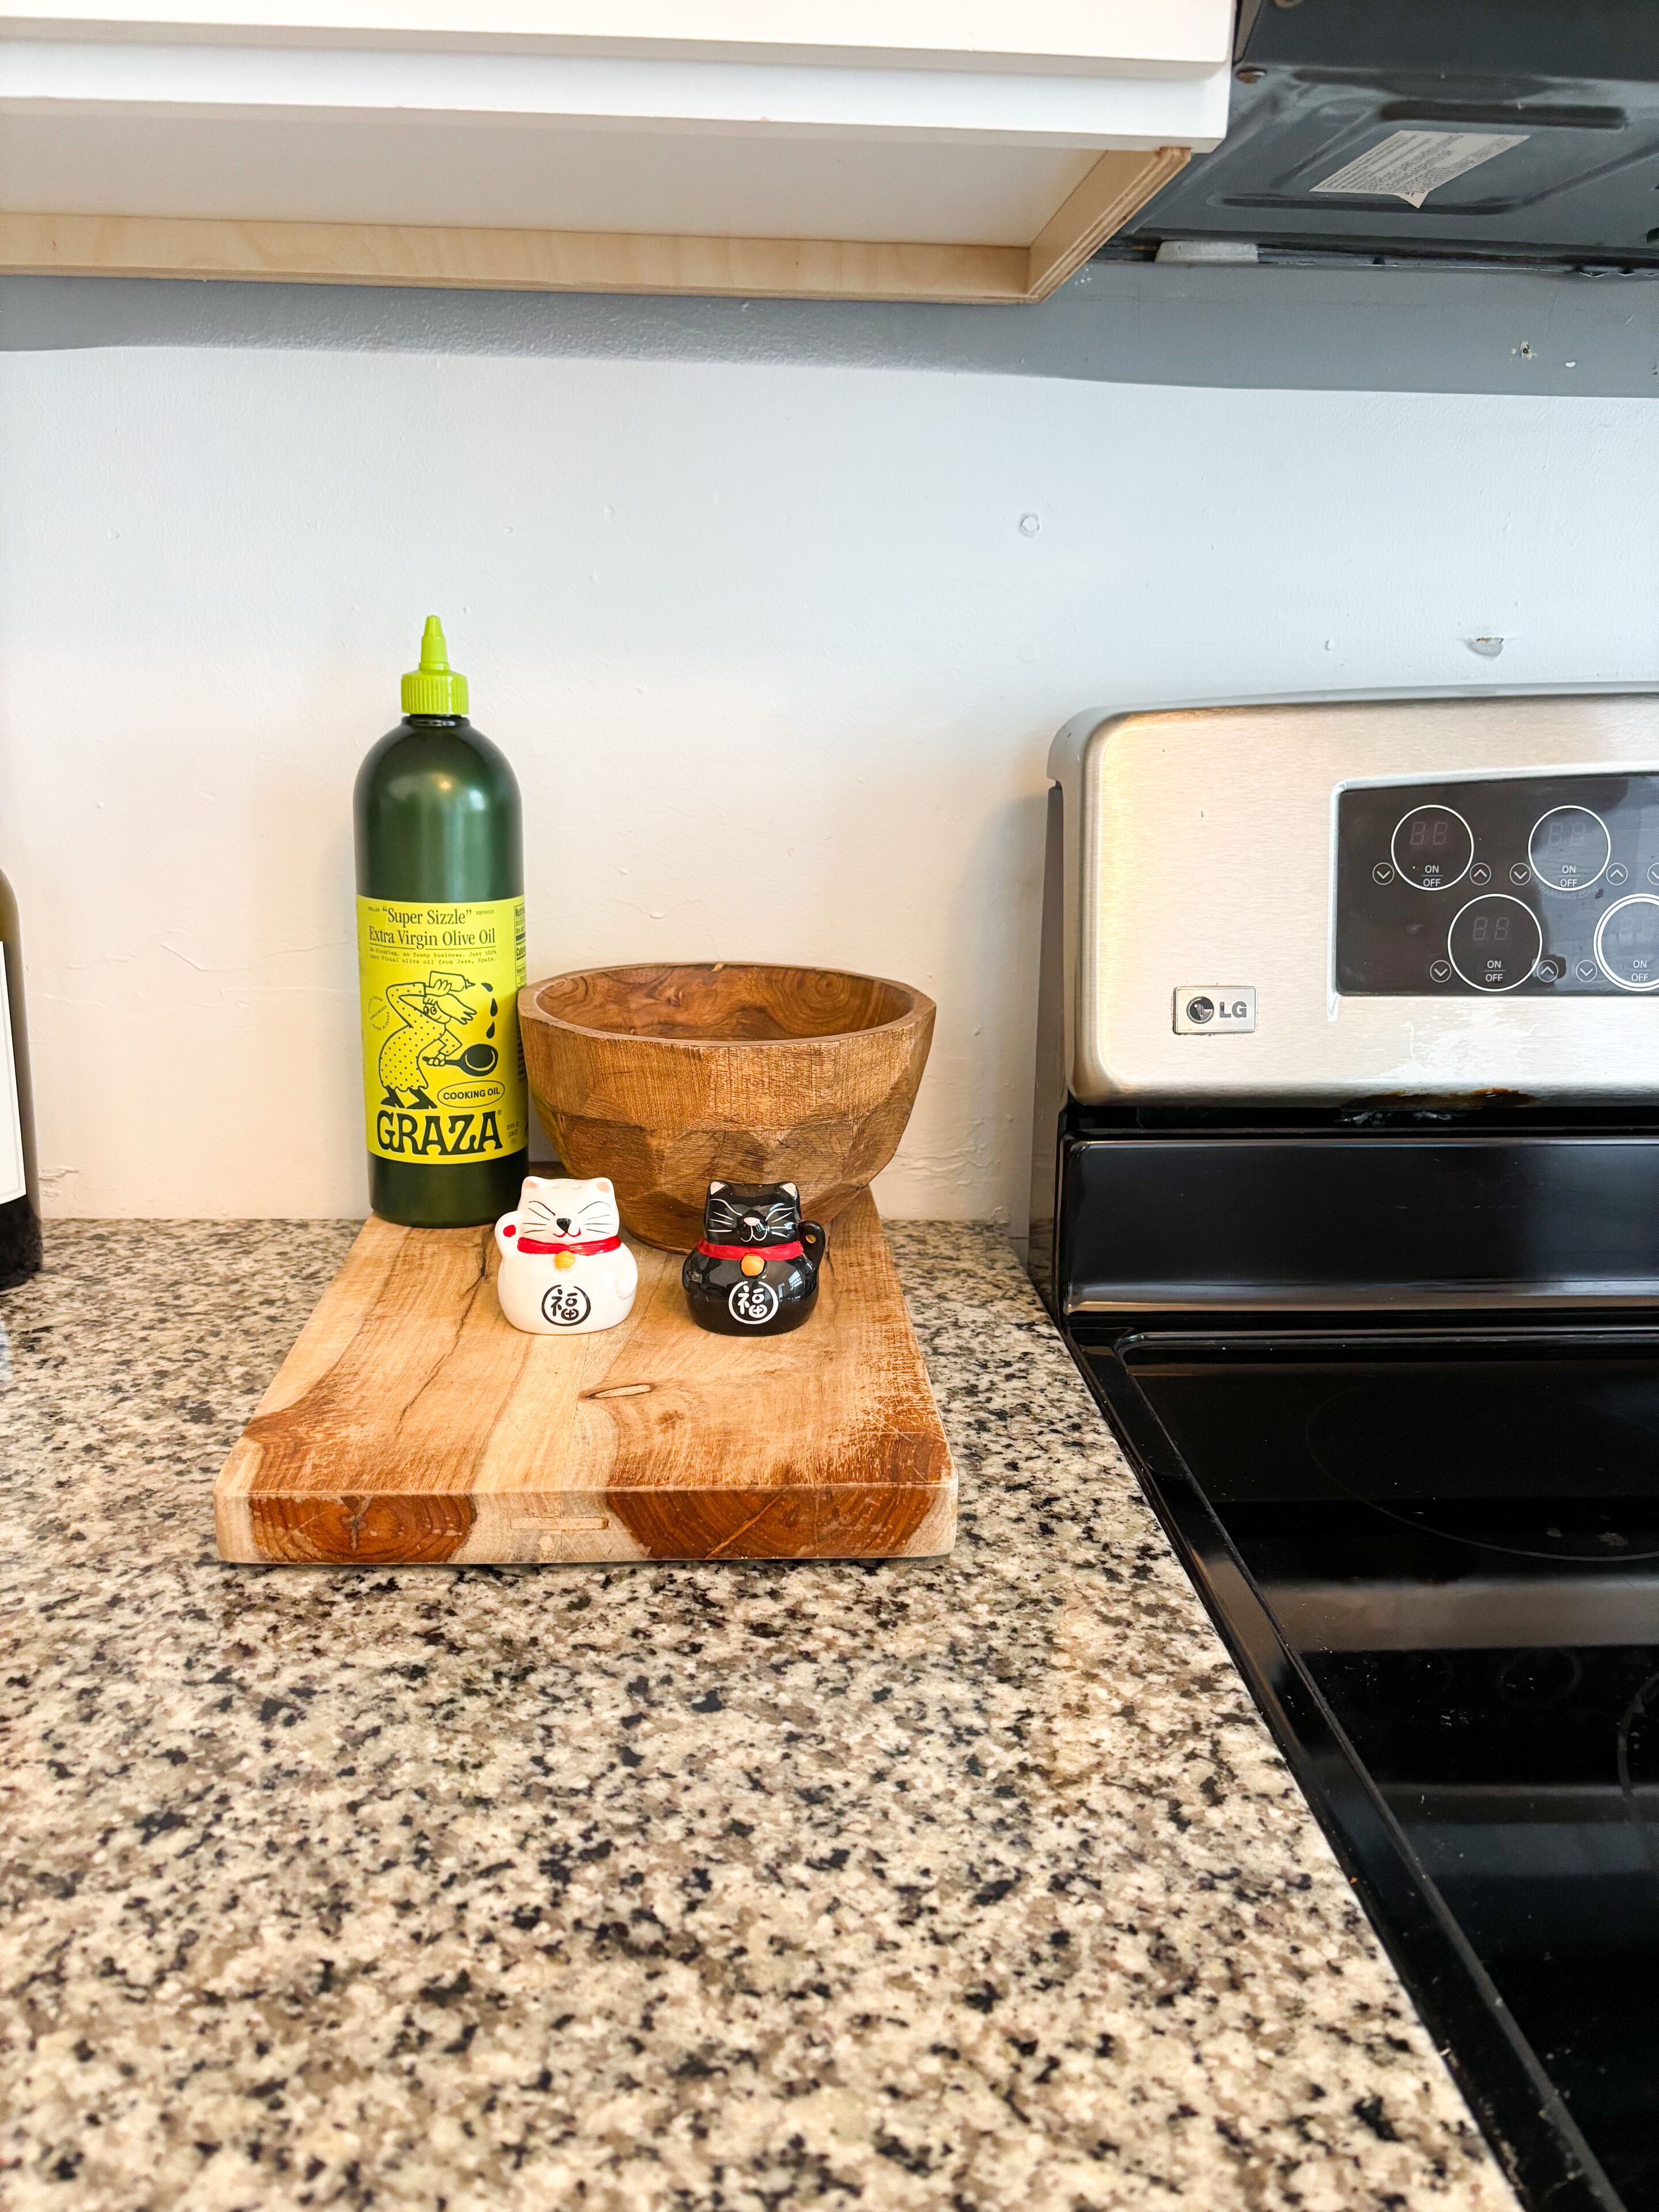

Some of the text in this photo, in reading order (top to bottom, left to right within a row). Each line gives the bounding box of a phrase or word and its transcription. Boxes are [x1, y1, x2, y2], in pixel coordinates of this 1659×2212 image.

[1424, 865, 1440, 873] ON
[1562, 865, 1576, 874] ON
[1423, 878, 1441, 887] OFF
[1560, 878, 1578, 888] OFF
[1539, 883, 1576, 900] WARMING
[369, 925, 395, 944] Extra
[397, 930, 438, 950] Virgin
[442, 930, 475, 946] Olive
[479, 927, 495, 944] Oil
[1487, 960, 1502, 968] ON
[1633, 960, 1647, 968] ON
[1485, 974, 1503, 982] OFF
[1631, 973, 1648, 982] OFF
[1219, 1001, 1247, 1018] LG
[443, 1087, 500, 1100] COOKING OIL
[551, 1289, 579, 1320] 福
[738, 1285, 767, 1318] 福
